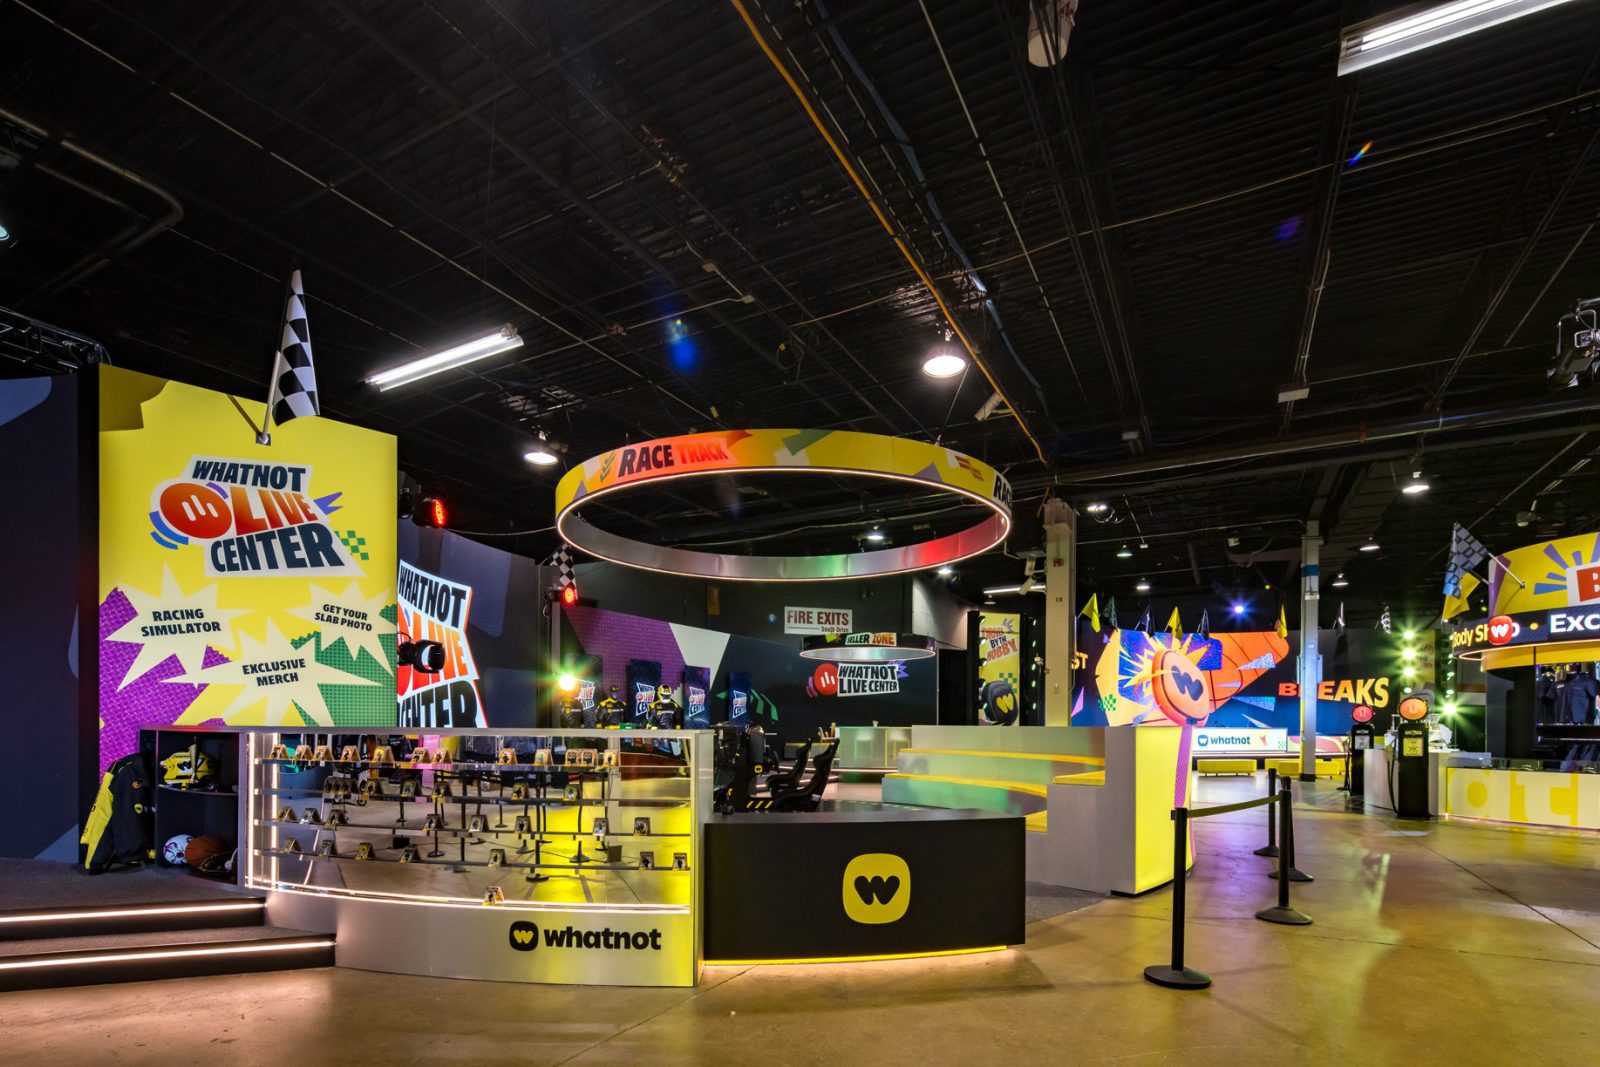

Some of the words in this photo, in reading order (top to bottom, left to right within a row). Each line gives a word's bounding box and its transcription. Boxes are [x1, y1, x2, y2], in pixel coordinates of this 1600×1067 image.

[618, 444, 675, 478] RACE
[676, 442, 729, 465] TRACK
[192, 460, 306, 492] WHATNOT
[229, 486, 318, 536] LIVE
[211, 522, 345, 572] CENTER
[399, 564, 467, 628] WHATNOT
[152, 608, 205, 622] RACING
[322, 604, 341, 614] GET
[343, 607, 368, 620] YOUR
[787, 610, 813, 624] FIRE
[817, 611, 849, 626] EXITS
[141, 621, 221, 637] SIMULATOR
[315, 612, 339, 624] SLAB
[340, 619, 372, 632] PHOTO
[847, 633, 870, 644] SELLER
[872, 633, 895, 645] ZONE
[412, 610, 469, 692] LIVE
[242, 658, 306, 675] EXCLUSIVE
[838, 665, 897, 680] WHATNOT
[256, 672, 299, 687] MERCH
[839, 678, 868, 694] LIVE
[868, 680, 898, 693] CENTER
[1278, 676, 1390, 708] BEAKS
[397, 680, 478, 728] ENTER
[1210, 735, 1251, 745] whatnot
[543, 926, 662, 950] whatnot
